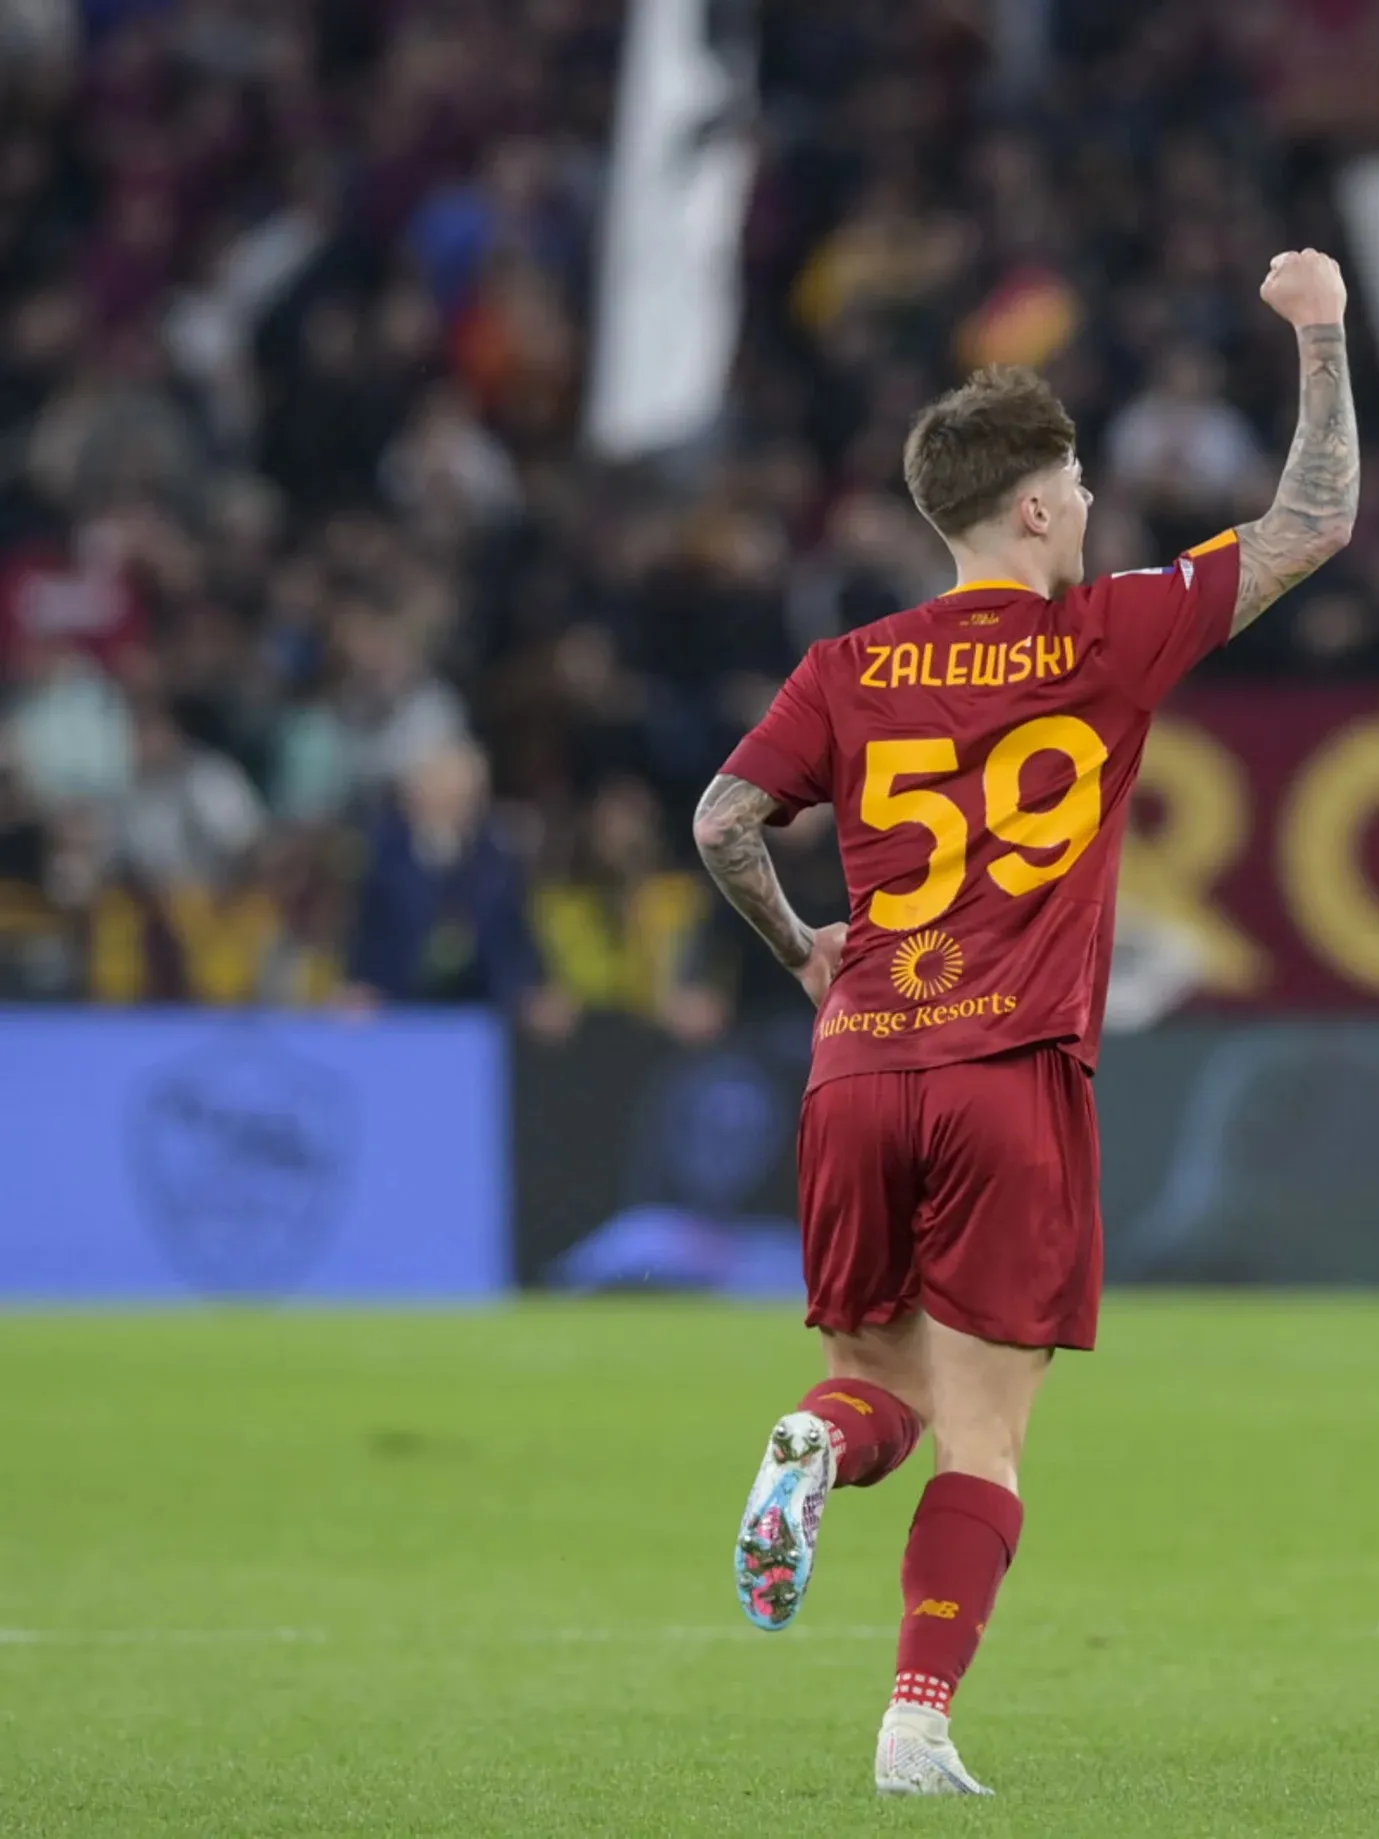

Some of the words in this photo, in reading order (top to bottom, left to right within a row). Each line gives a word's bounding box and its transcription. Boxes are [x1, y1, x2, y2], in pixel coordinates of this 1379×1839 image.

[860, 635, 1075, 689] ZALEWSKI
[860, 714, 1109, 932] 59
[913, 991, 1018, 1029] Resorts
